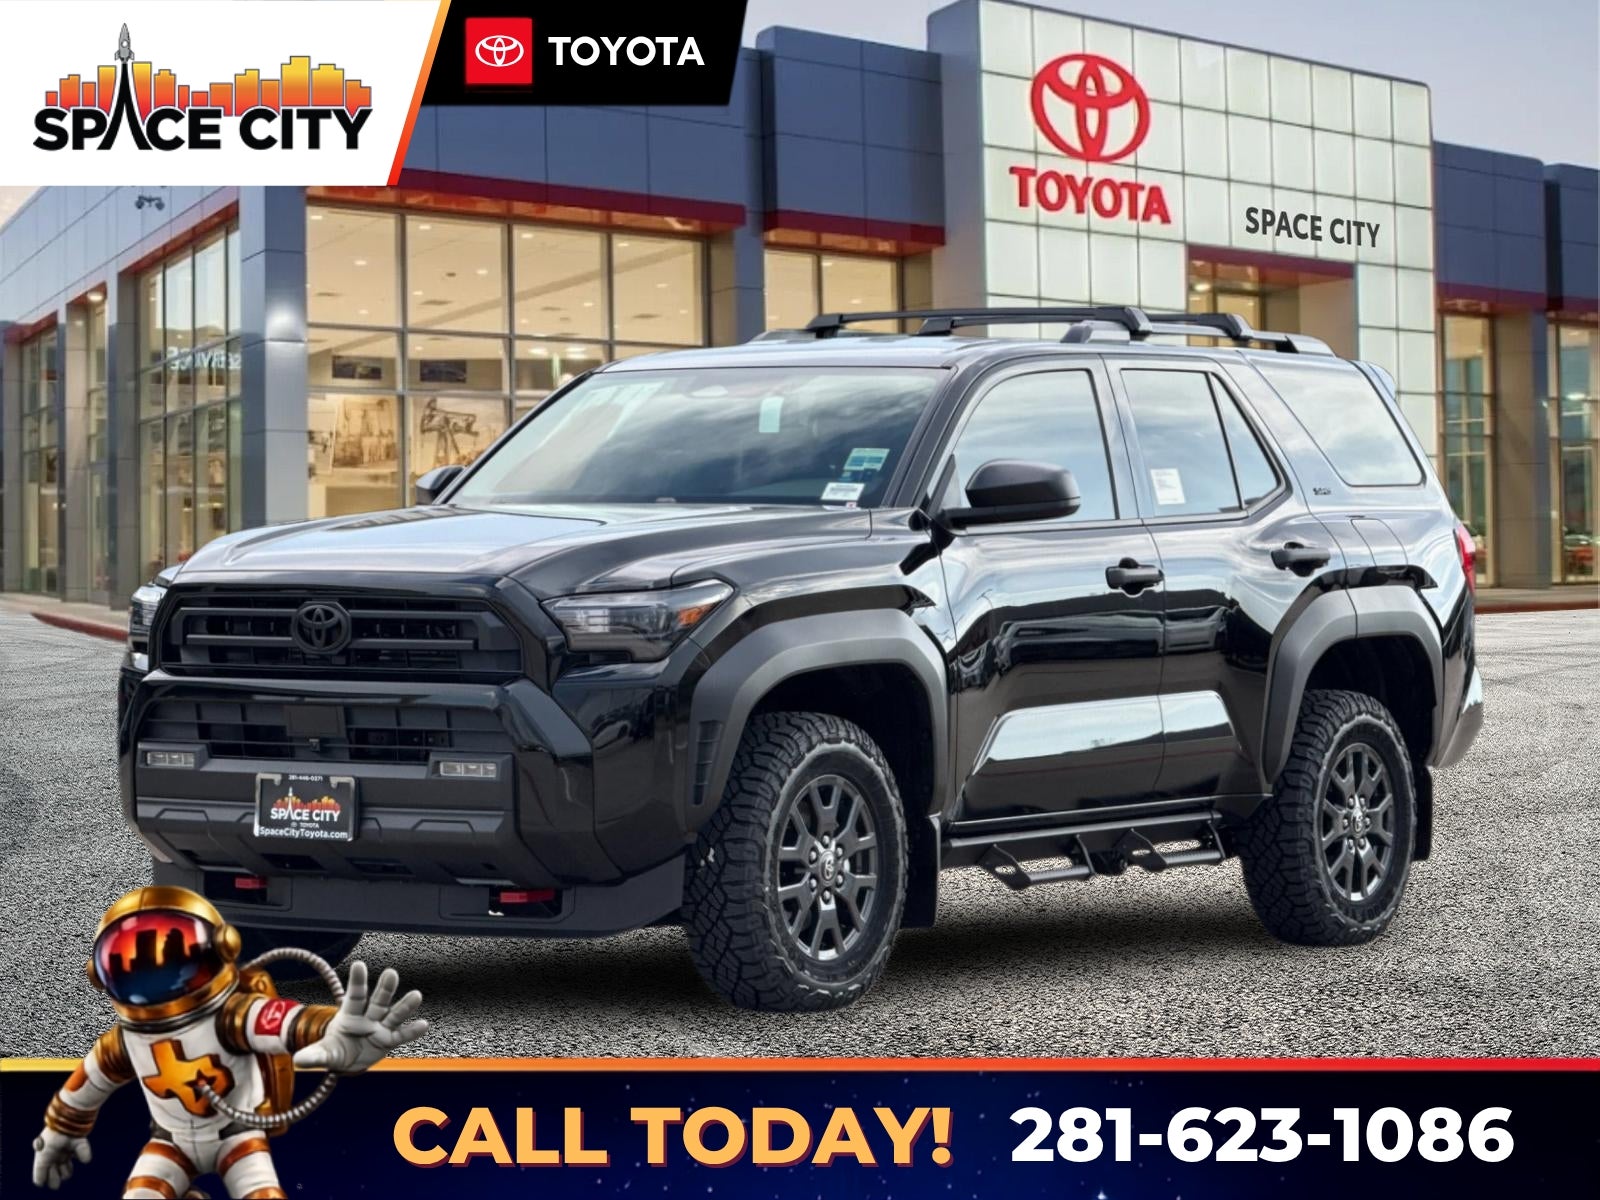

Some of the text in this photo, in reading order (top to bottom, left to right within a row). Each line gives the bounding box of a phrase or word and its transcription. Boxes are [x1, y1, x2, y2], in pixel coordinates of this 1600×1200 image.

[1009, 166, 1171, 224] TOYOTA
[1245, 206, 1381, 248] SPACE CITY
[270, 807, 341, 821] SPACE CITY
[260, 826, 348, 838] SpaceCityToyota.com
